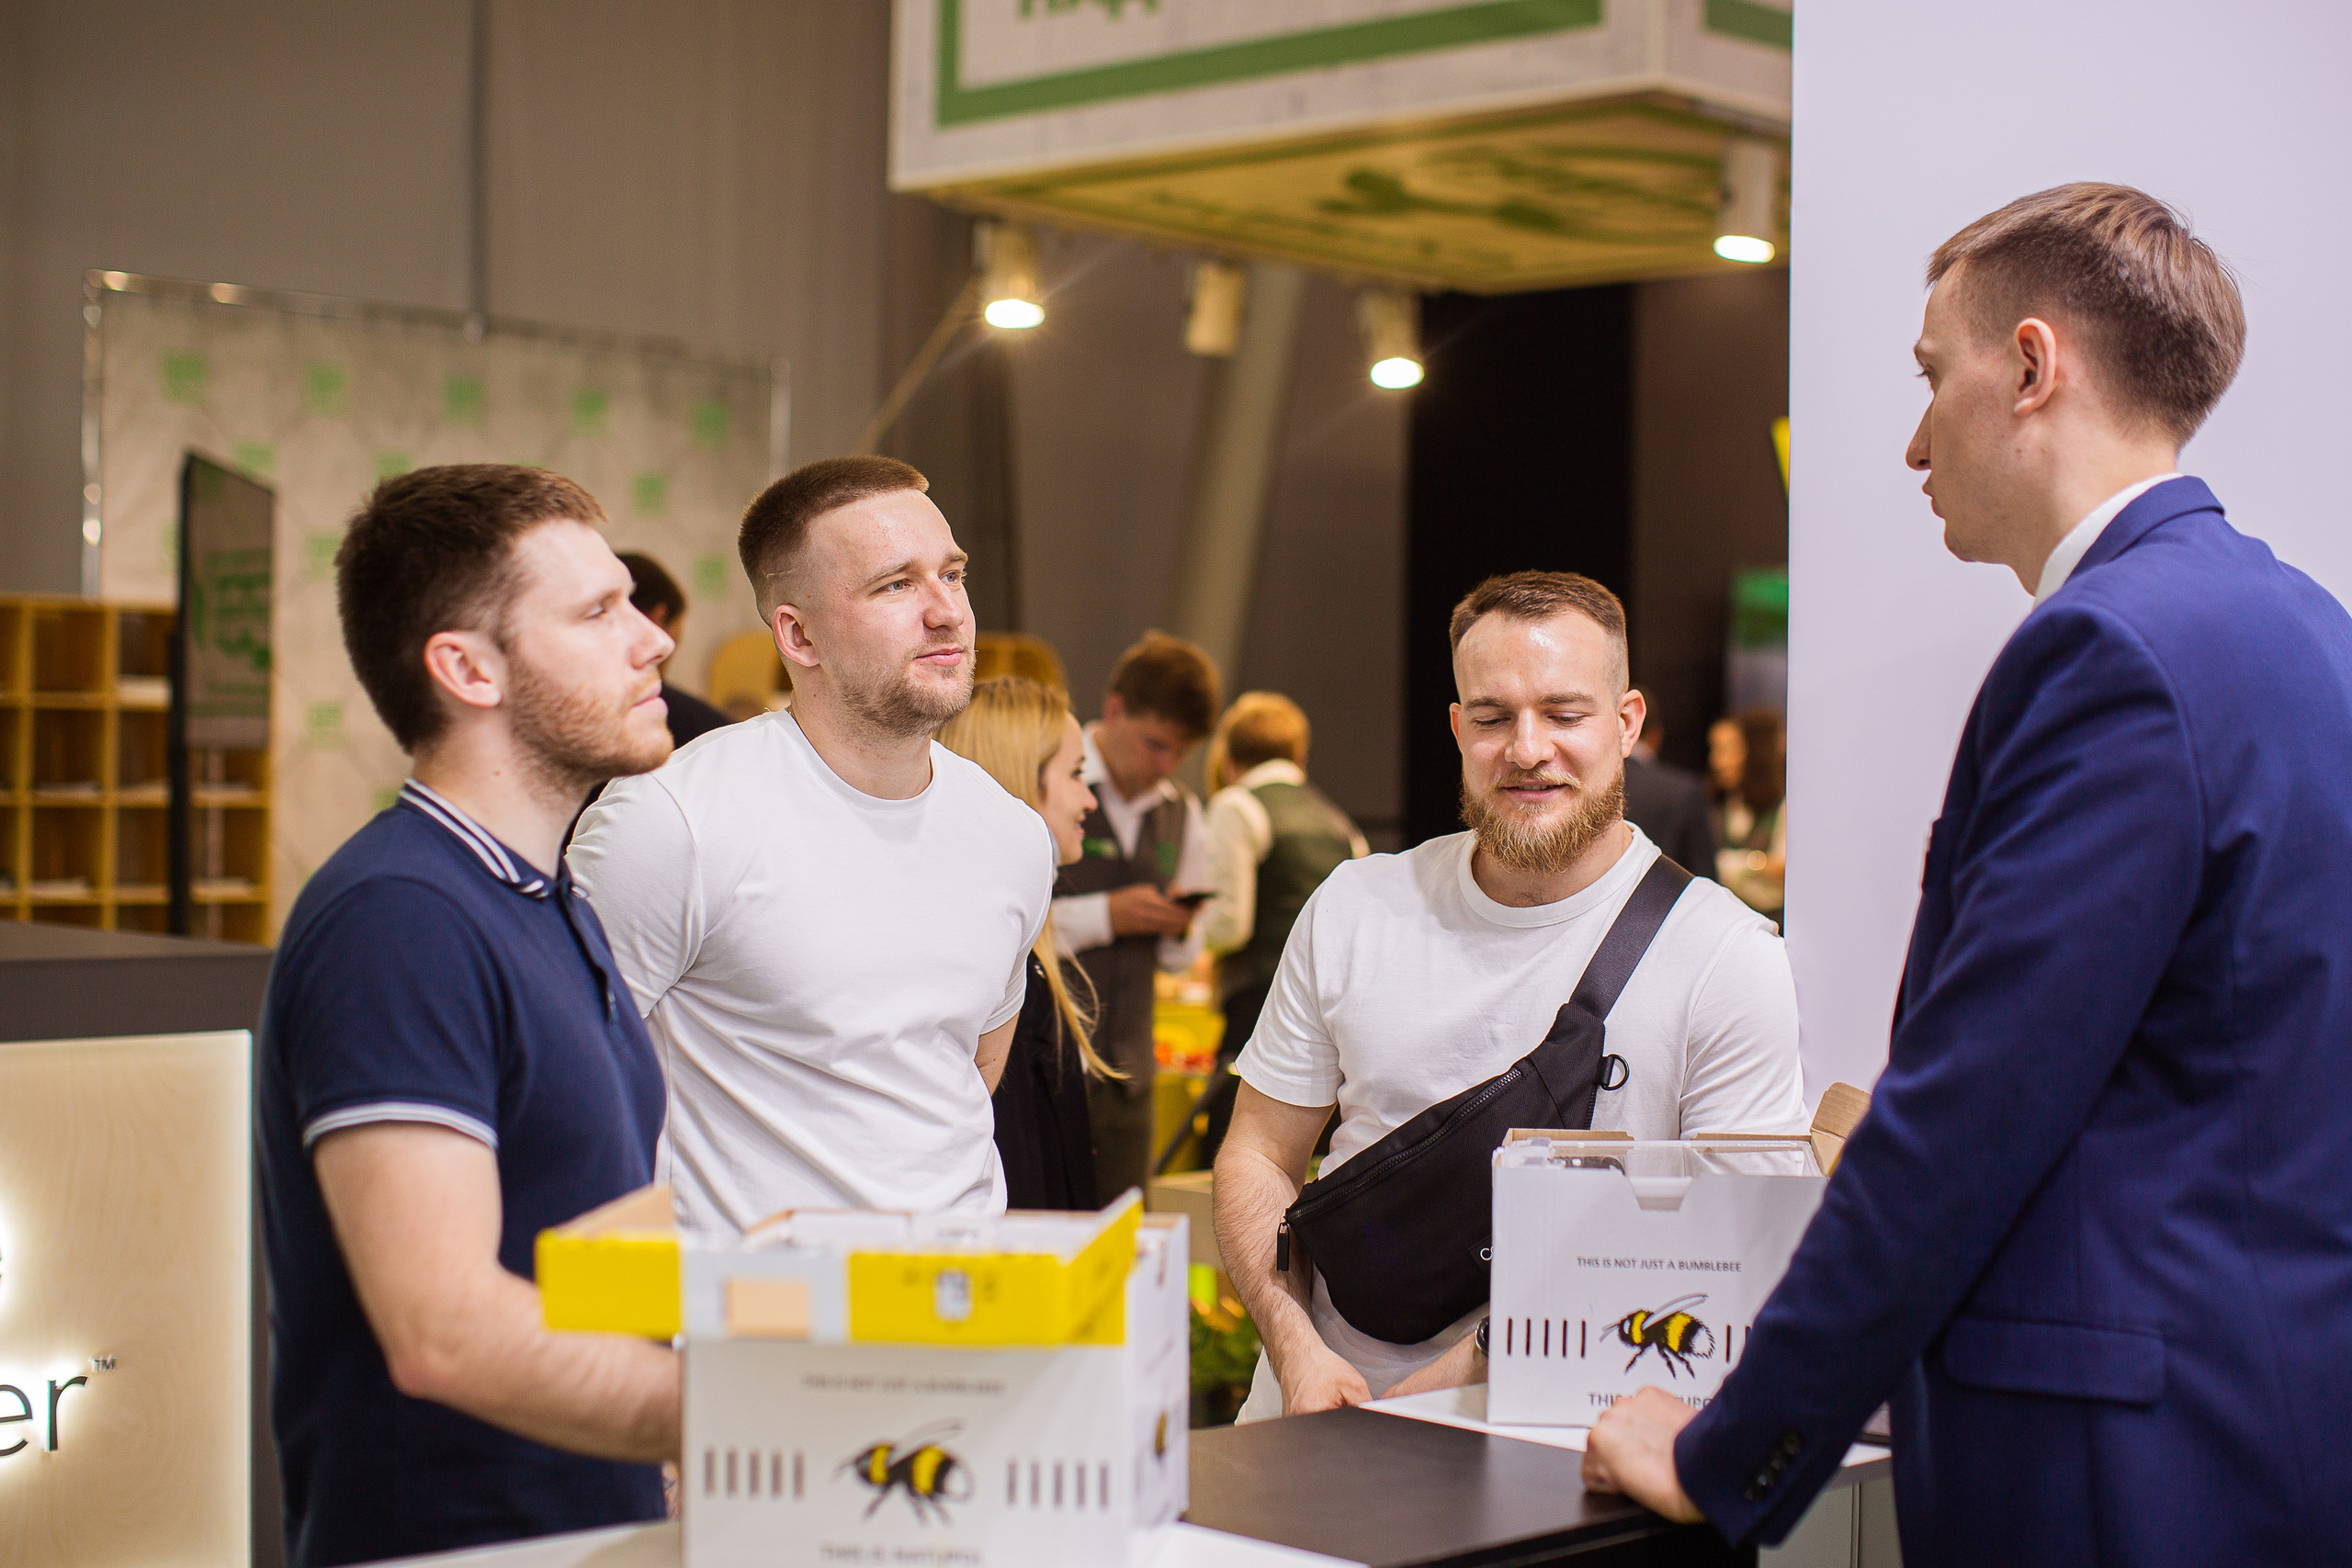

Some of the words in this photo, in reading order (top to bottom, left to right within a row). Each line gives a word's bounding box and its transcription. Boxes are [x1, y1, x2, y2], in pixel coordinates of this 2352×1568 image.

[1577, 1257, 1600, 1269] THIS
[1602, 1258, 1611, 1269] IS
[1614, 1258, 1637, 1269] NOT
[1640, 1259, 1665, 1270] JUST
[1668, 1259, 1676, 1270] A
[1679, 1260, 1742, 1273] BUMBLEBEE
